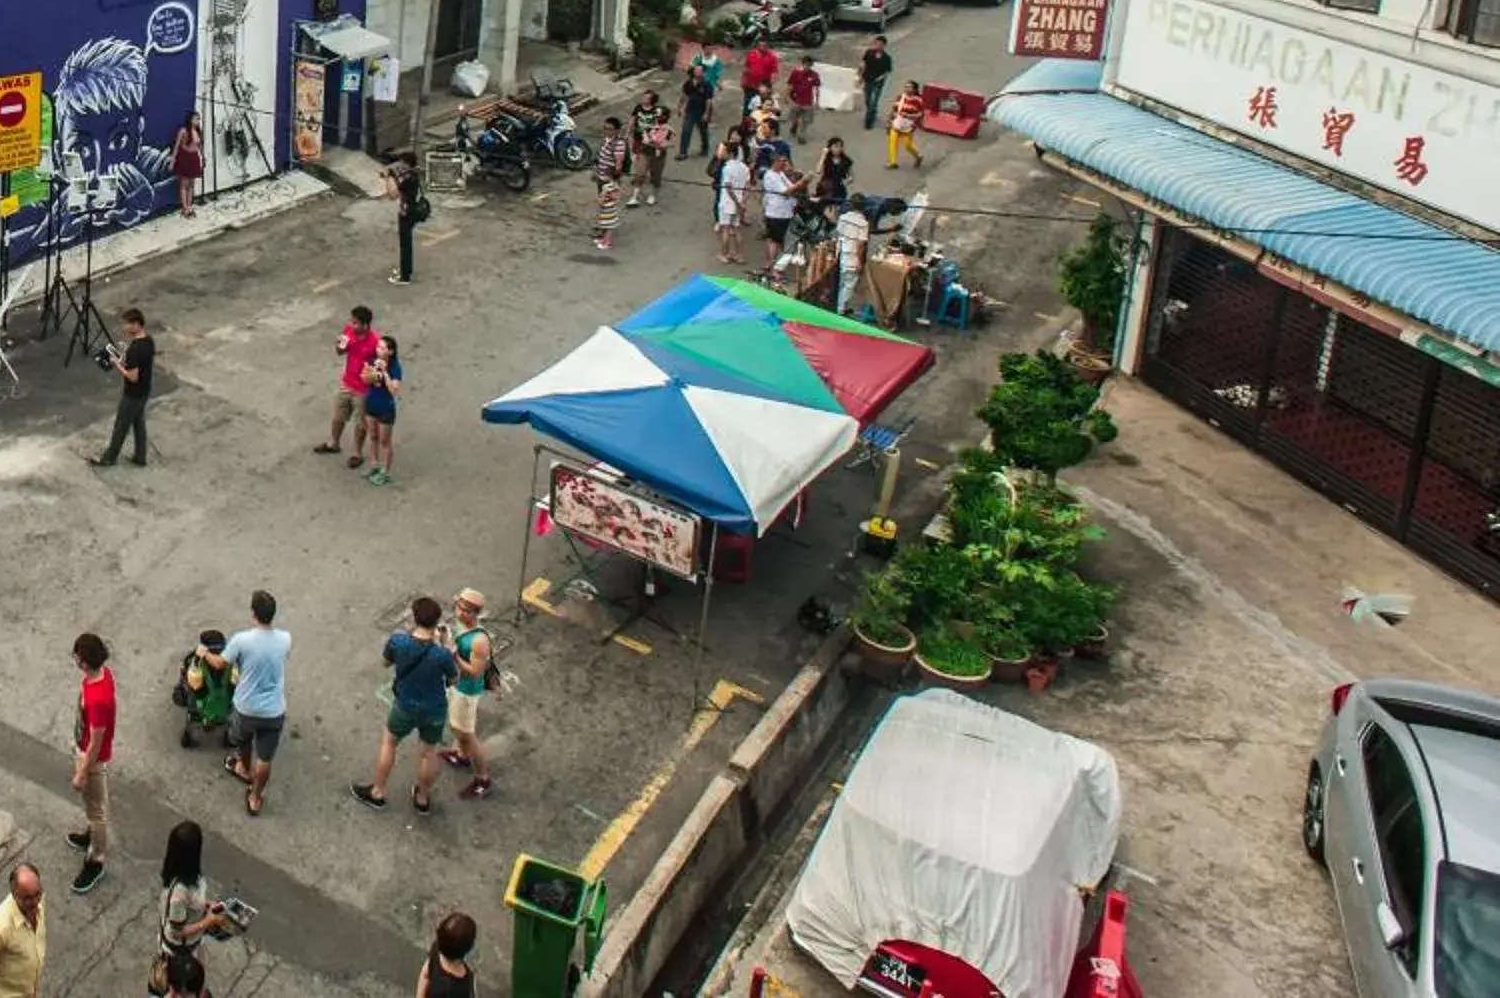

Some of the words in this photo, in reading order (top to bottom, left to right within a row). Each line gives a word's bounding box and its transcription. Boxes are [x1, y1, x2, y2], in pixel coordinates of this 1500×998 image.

[1027, 7, 1097, 33] ZHANG
[1248, 86, 1429, 187] 張貿易
